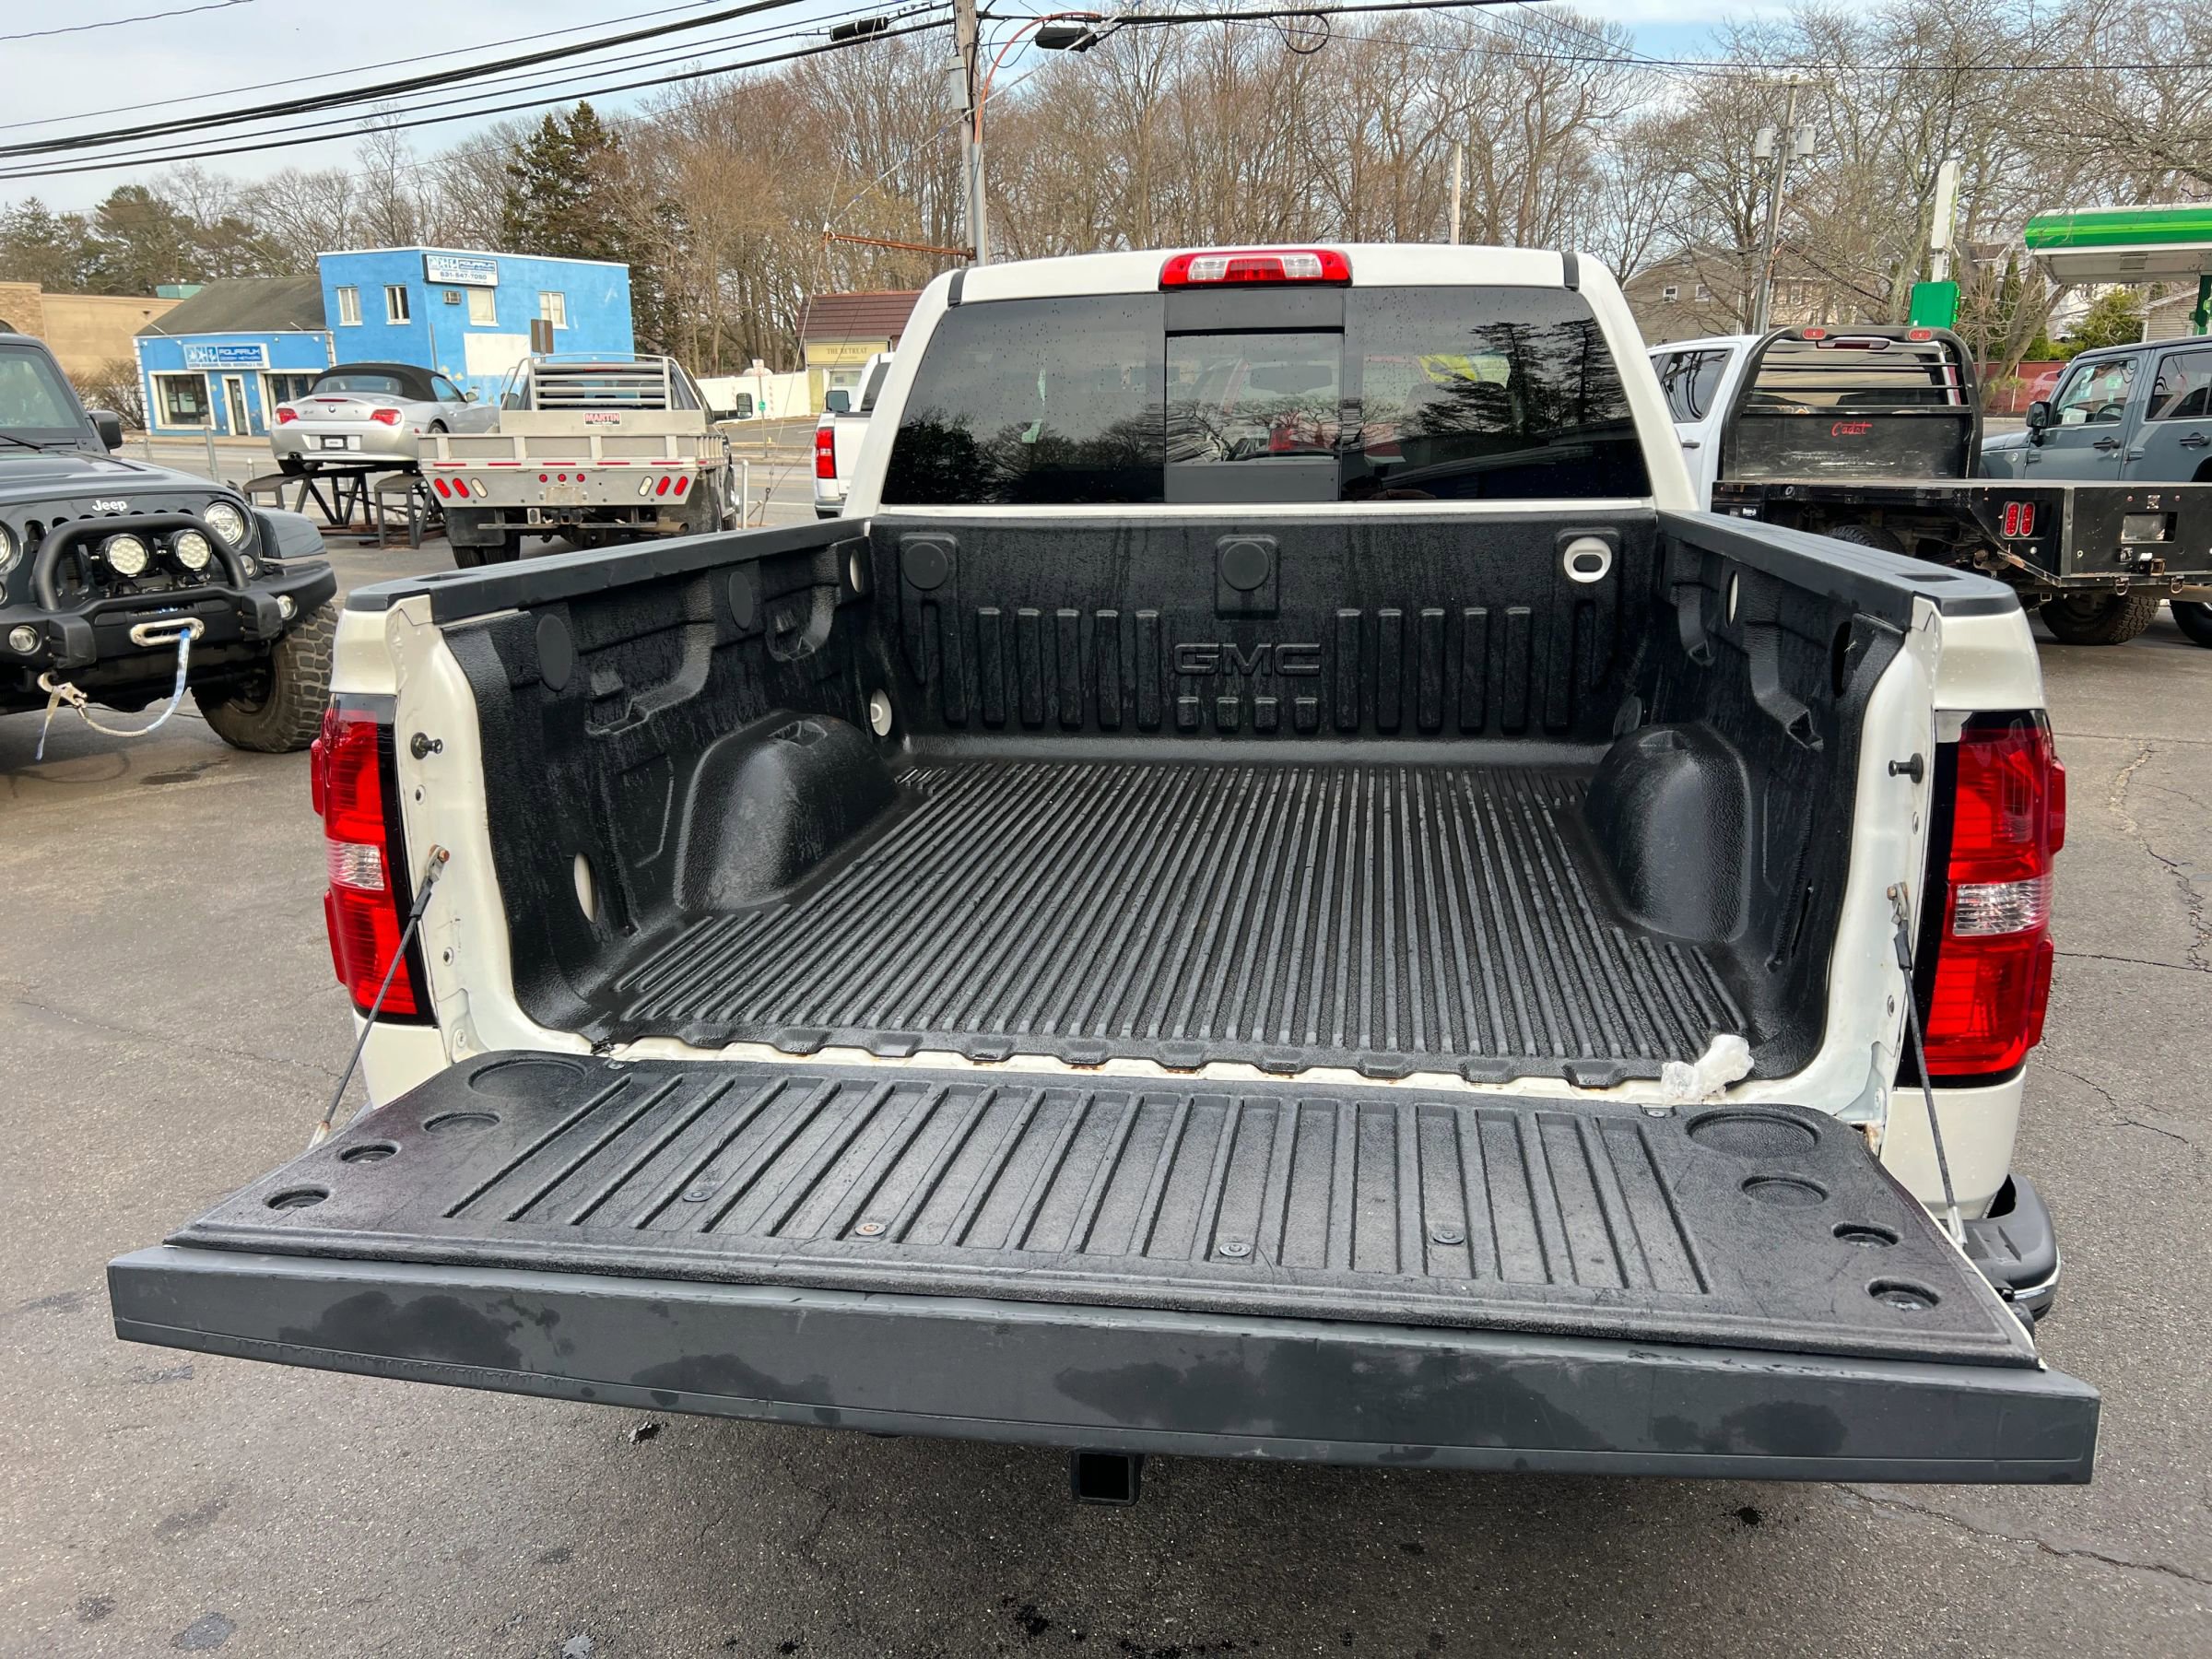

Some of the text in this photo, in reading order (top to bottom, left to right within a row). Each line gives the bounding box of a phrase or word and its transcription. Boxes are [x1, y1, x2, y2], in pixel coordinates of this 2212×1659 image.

[841, 347, 867, 355] RETREAT
[585, 412, 620, 422] MARTIN
[92, 500, 127, 512] Jeep
[1173, 643, 1321, 677] GMC
